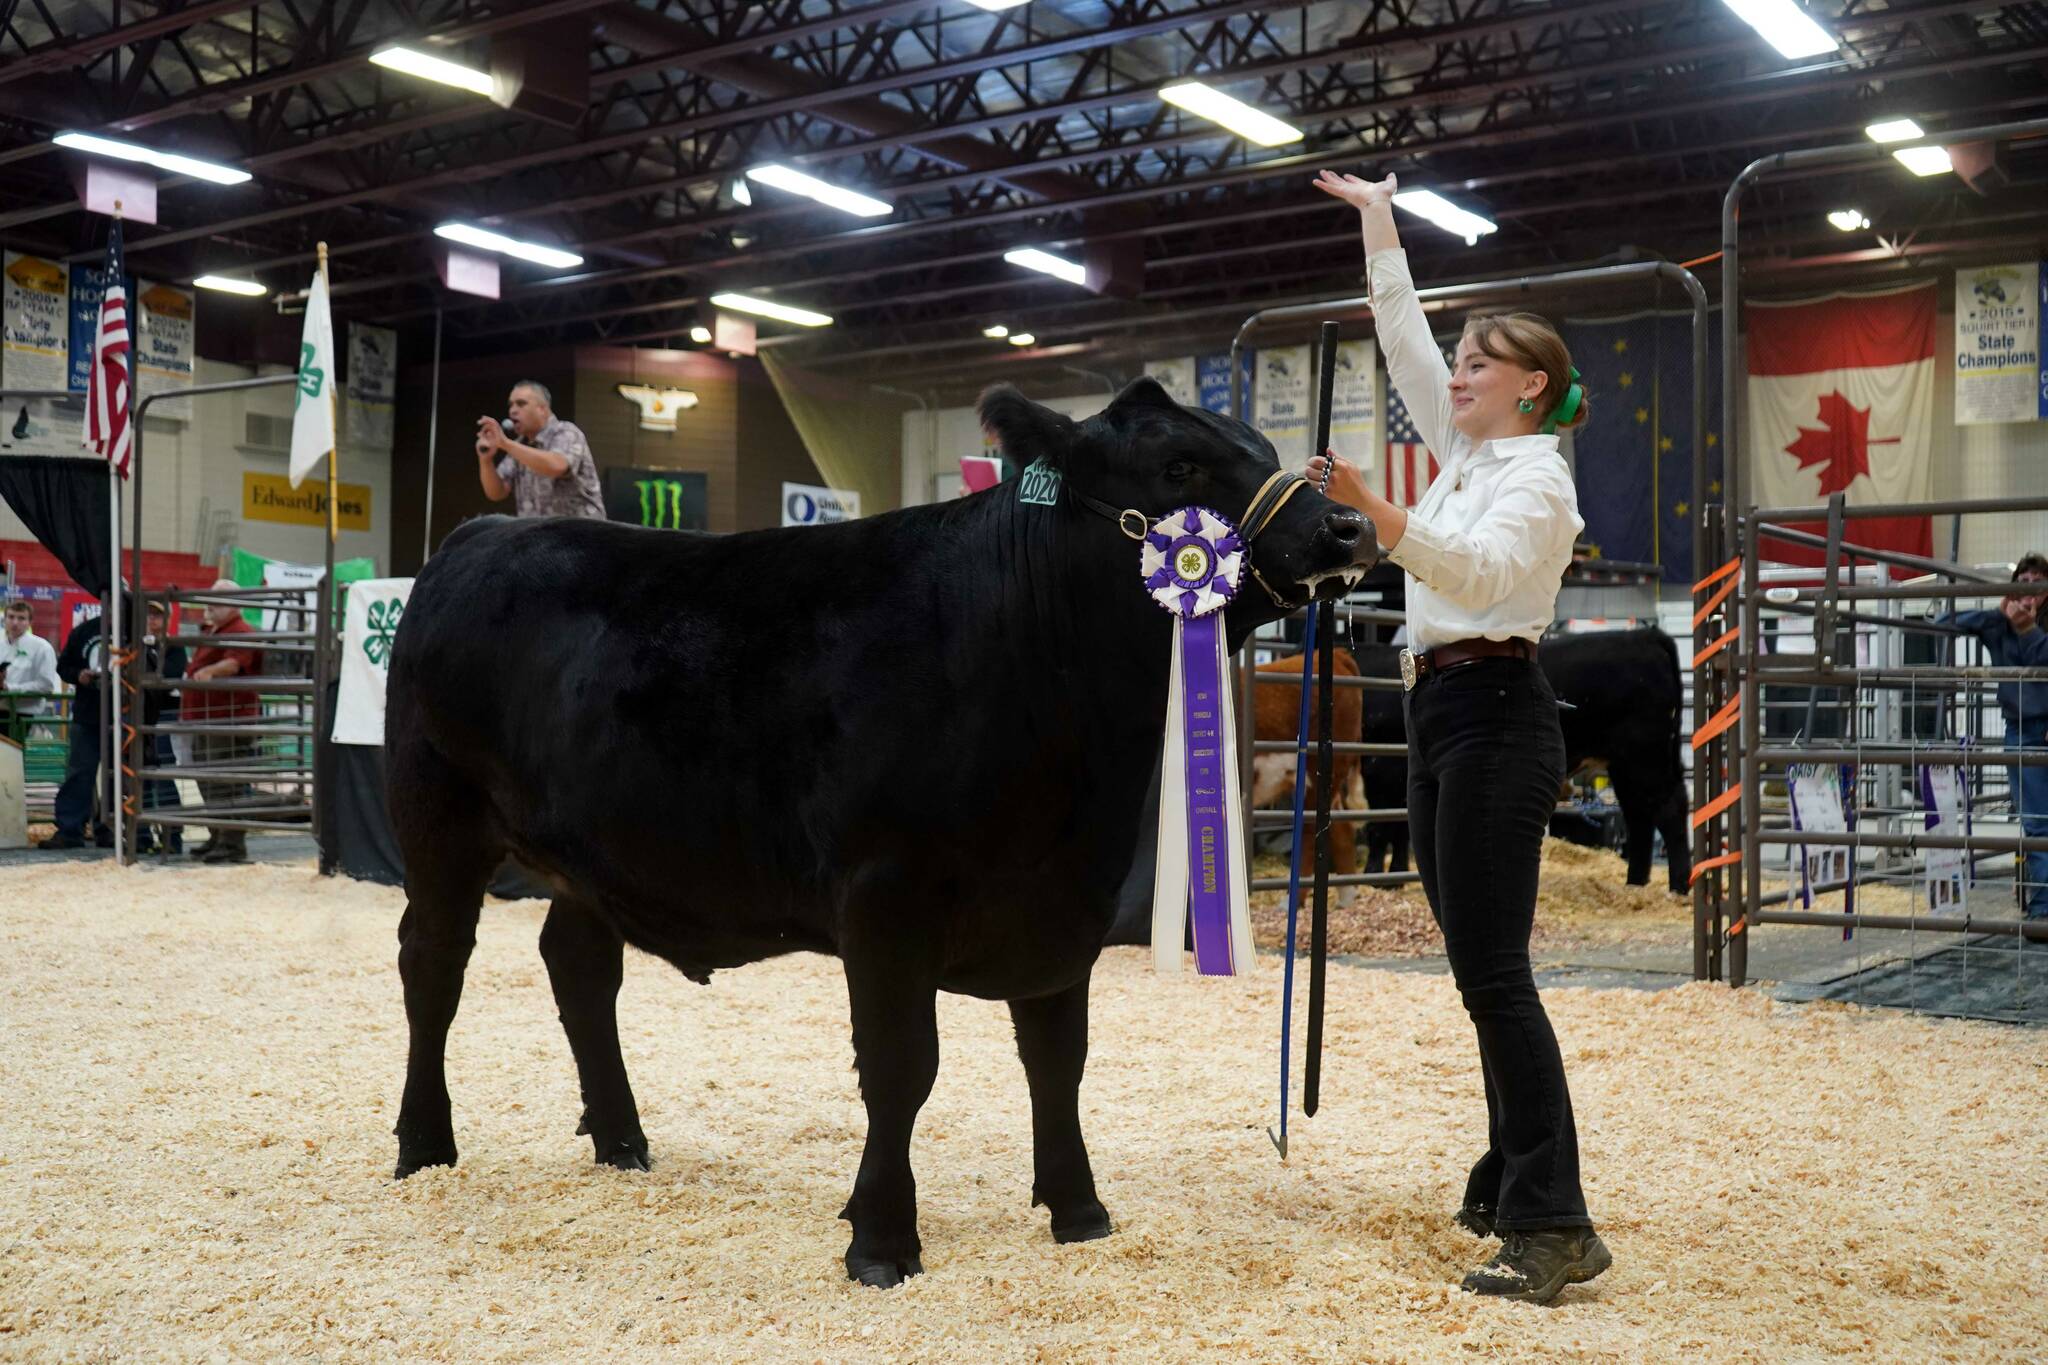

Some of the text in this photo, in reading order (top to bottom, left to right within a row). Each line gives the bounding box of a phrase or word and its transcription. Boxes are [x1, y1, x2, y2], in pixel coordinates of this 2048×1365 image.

[1979, 305, 2014, 320] 2015
[1960, 320, 2000, 335] SQUIRT
[2001, 319, 2026, 332] TIER
[152, 338, 178, 355] State
[1977, 333, 2016, 350] State
[137, 350, 192, 372] Champions
[1957, 350, 2037, 371] Champions
[1271, 402, 1296, 416] State
[1332, 408, 1373, 422] ampions
[1020, 470, 1060, 502] 2020
[252, 484, 313, 510] Edward
[1202, 826, 1217, 894] CHAMPION
